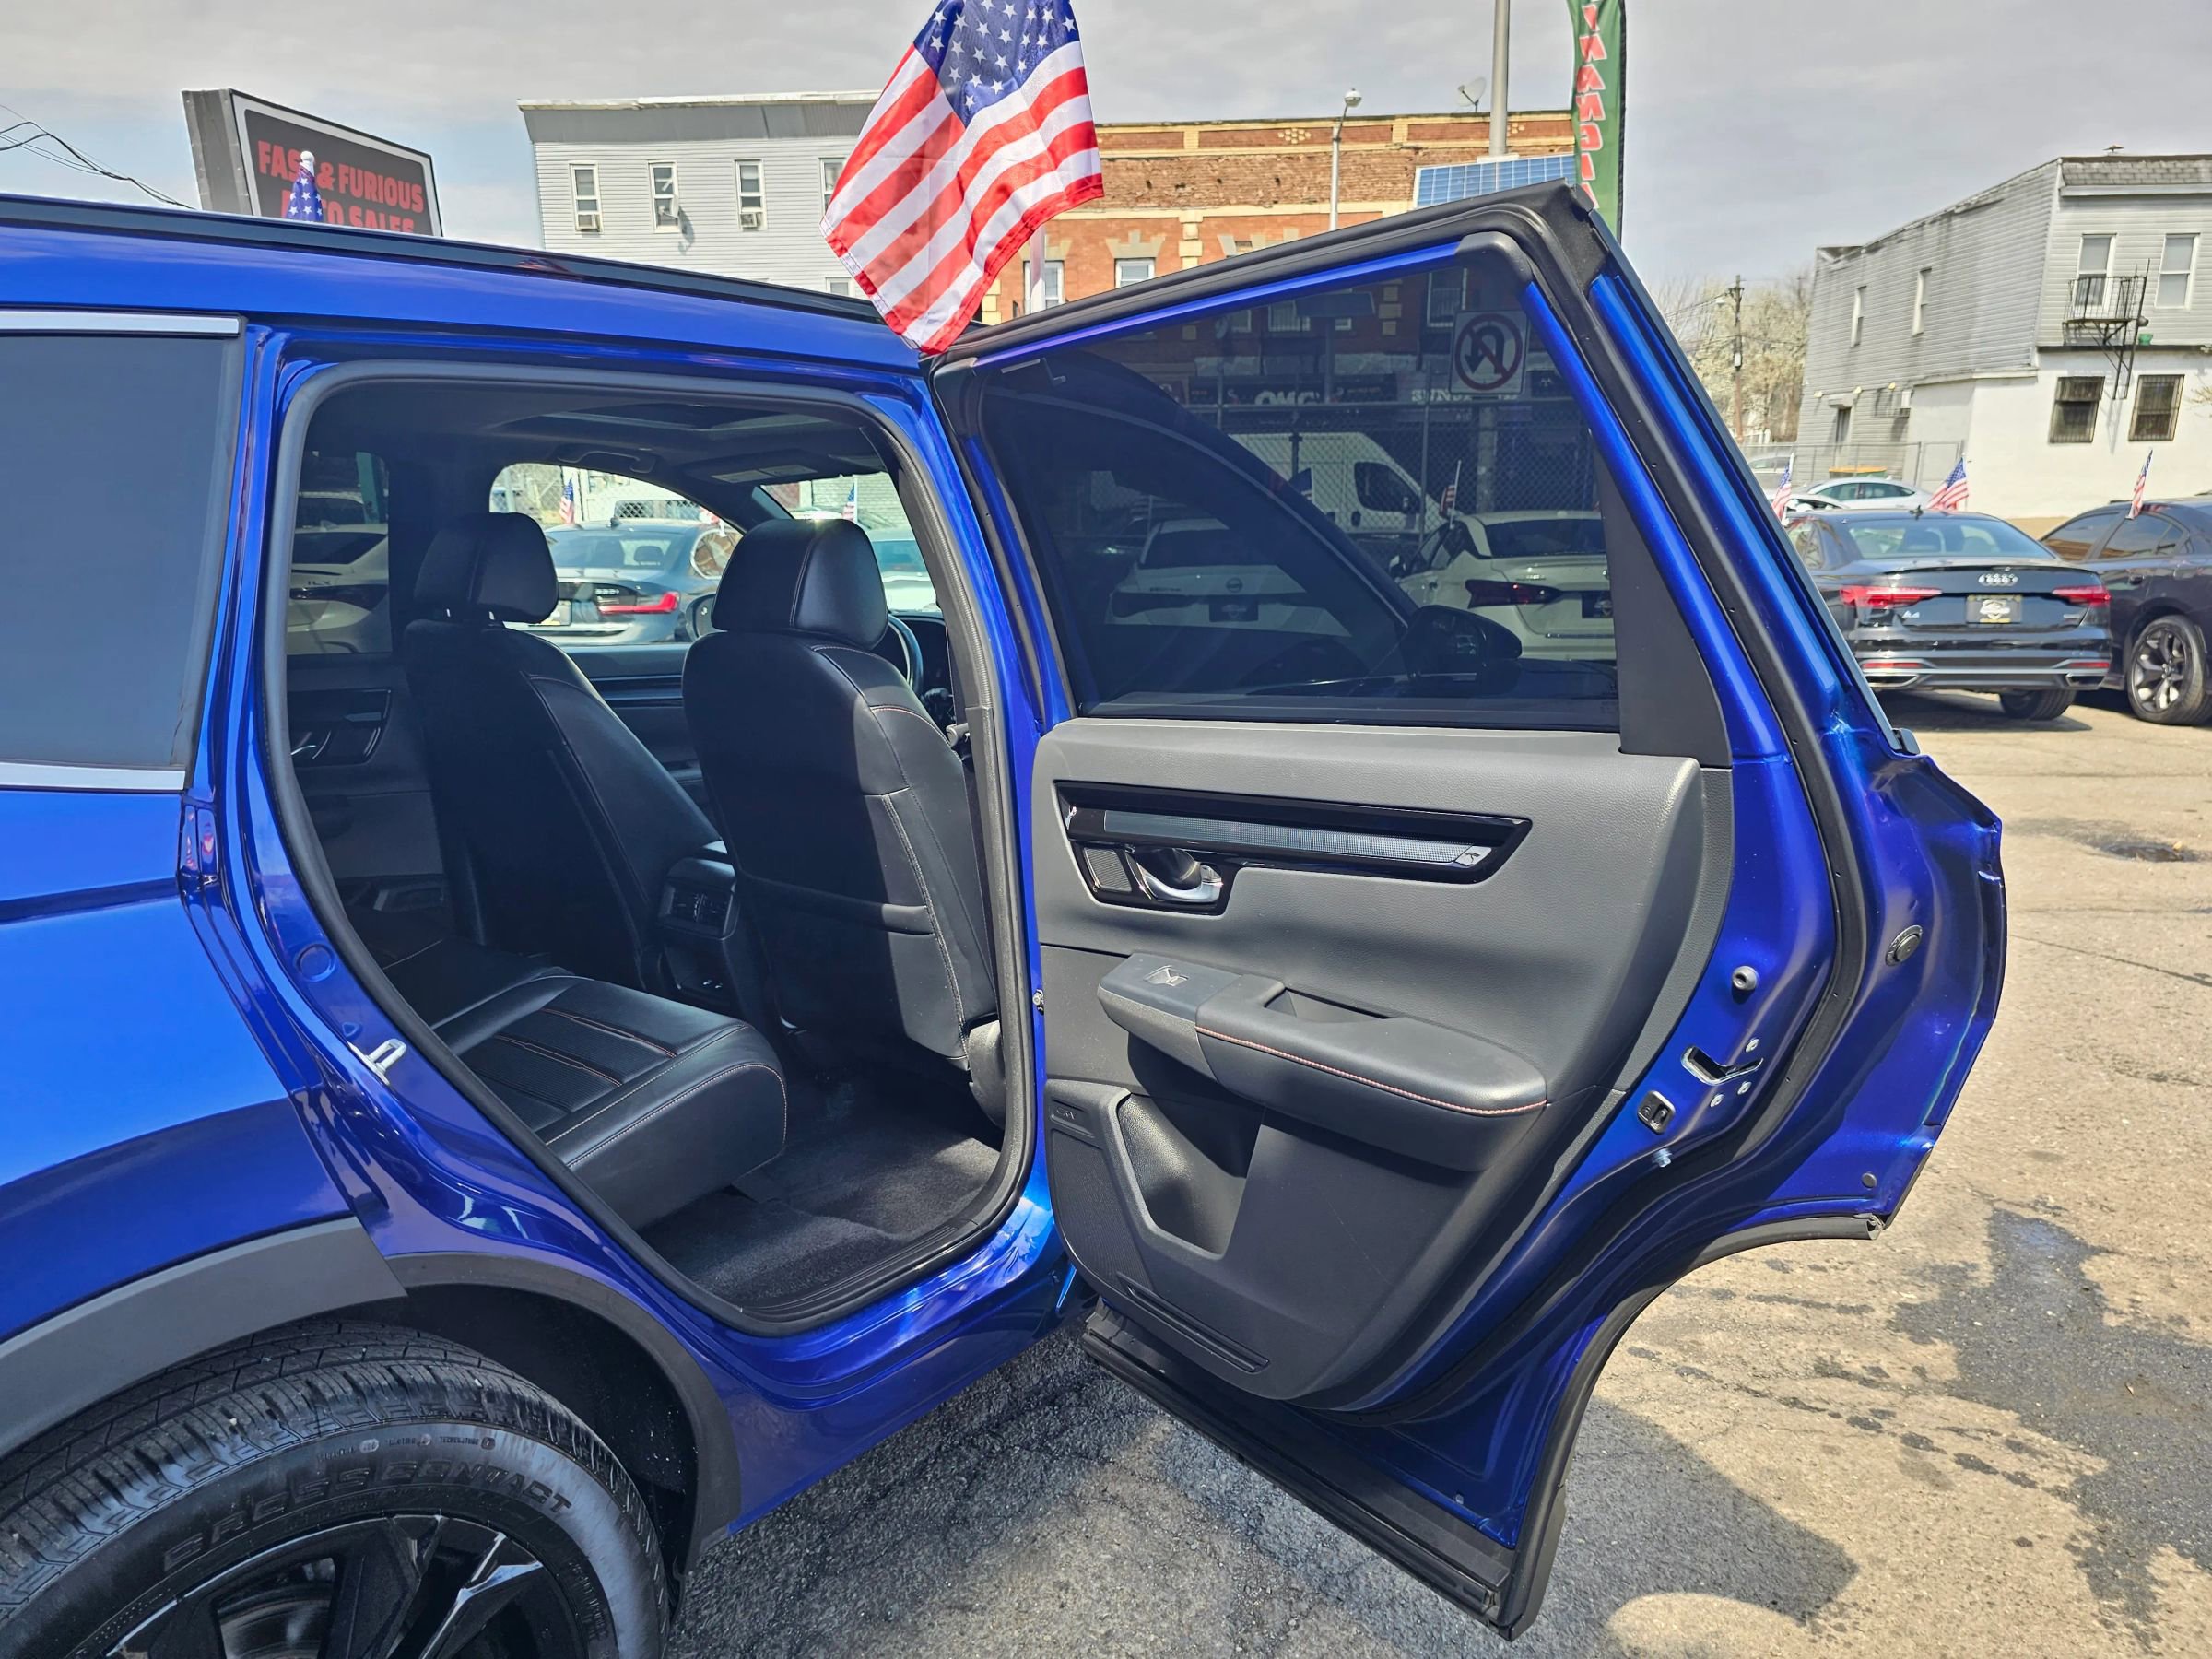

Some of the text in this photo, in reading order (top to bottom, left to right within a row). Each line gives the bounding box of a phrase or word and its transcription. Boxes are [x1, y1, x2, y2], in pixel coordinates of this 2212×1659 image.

[257, 140, 424, 214] FAS & FURIOUS
